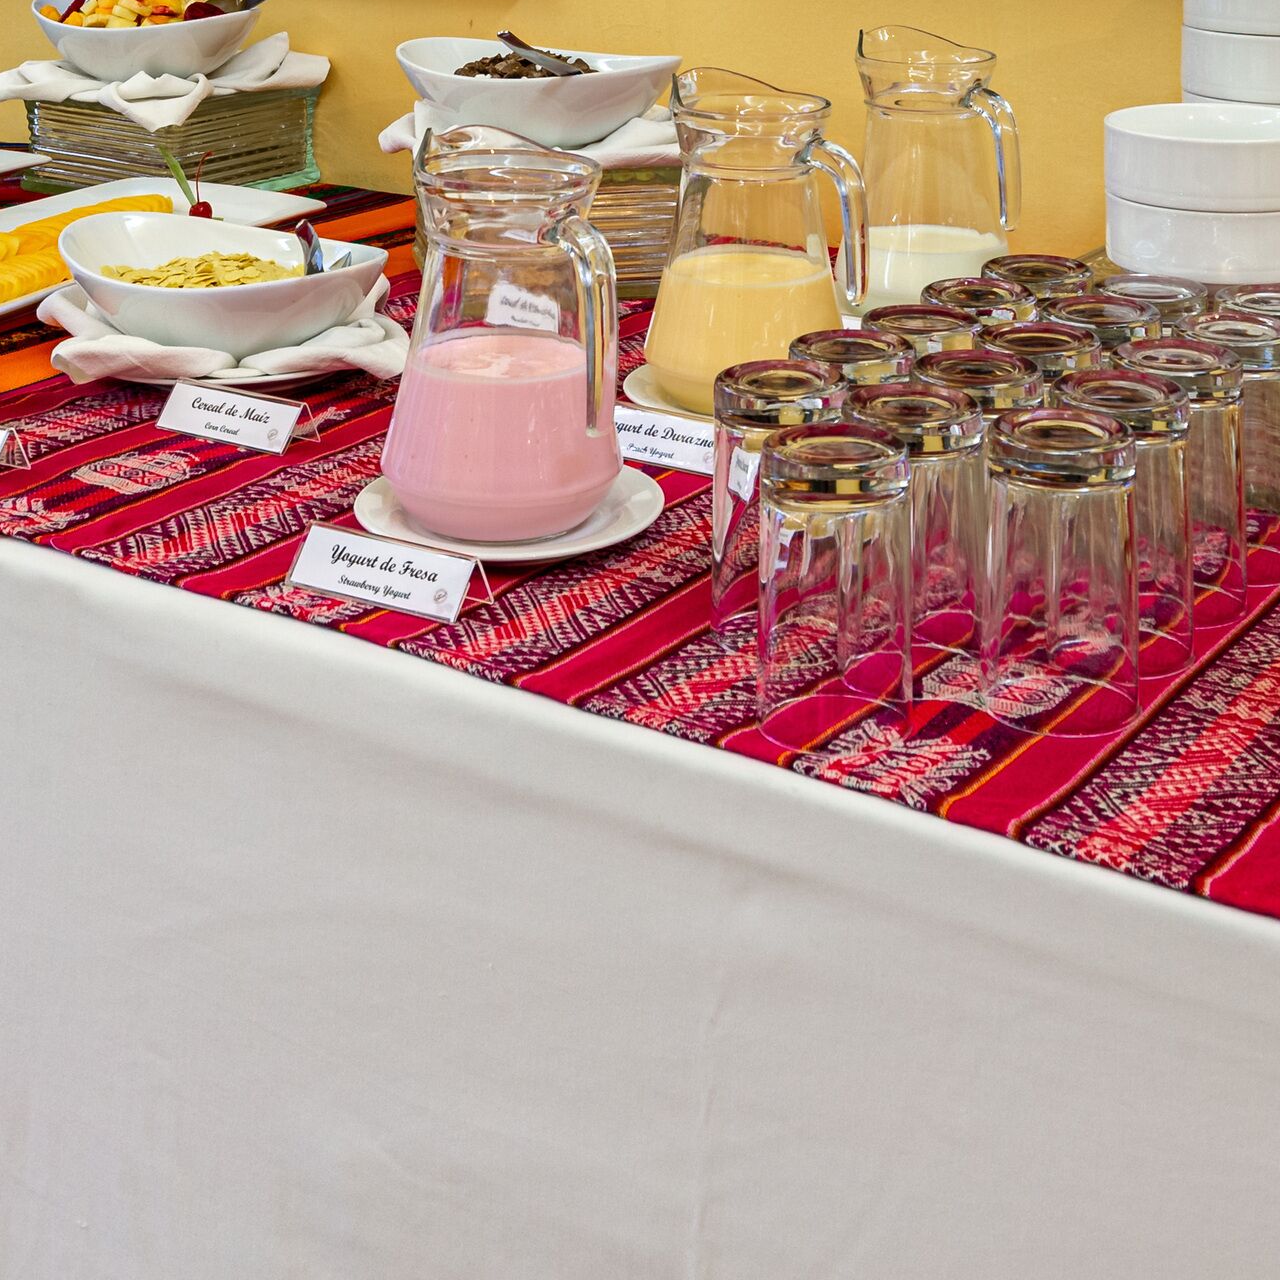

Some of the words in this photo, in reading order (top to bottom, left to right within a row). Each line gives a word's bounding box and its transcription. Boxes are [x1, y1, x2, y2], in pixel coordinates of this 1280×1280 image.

[191, 396, 227, 414] Cereal
[224, 403, 239, 418] de
[239, 406, 270, 425] Maíz
[204, 421, 219, 432] Corn
[219, 424, 241, 436] Cereal
[614, 421, 644, 437] gurt
[643, 423, 660, 439] de
[660, 426, 714, 449] Durazno
[649, 445, 675, 460] Yogurt
[330, 543, 380, 569] Yogurt
[379, 556, 397, 574] de
[398, 559, 440, 584] Fresa
[337, 574, 381, 595] Strawberry
[382, 583, 413, 601] Yogurt
